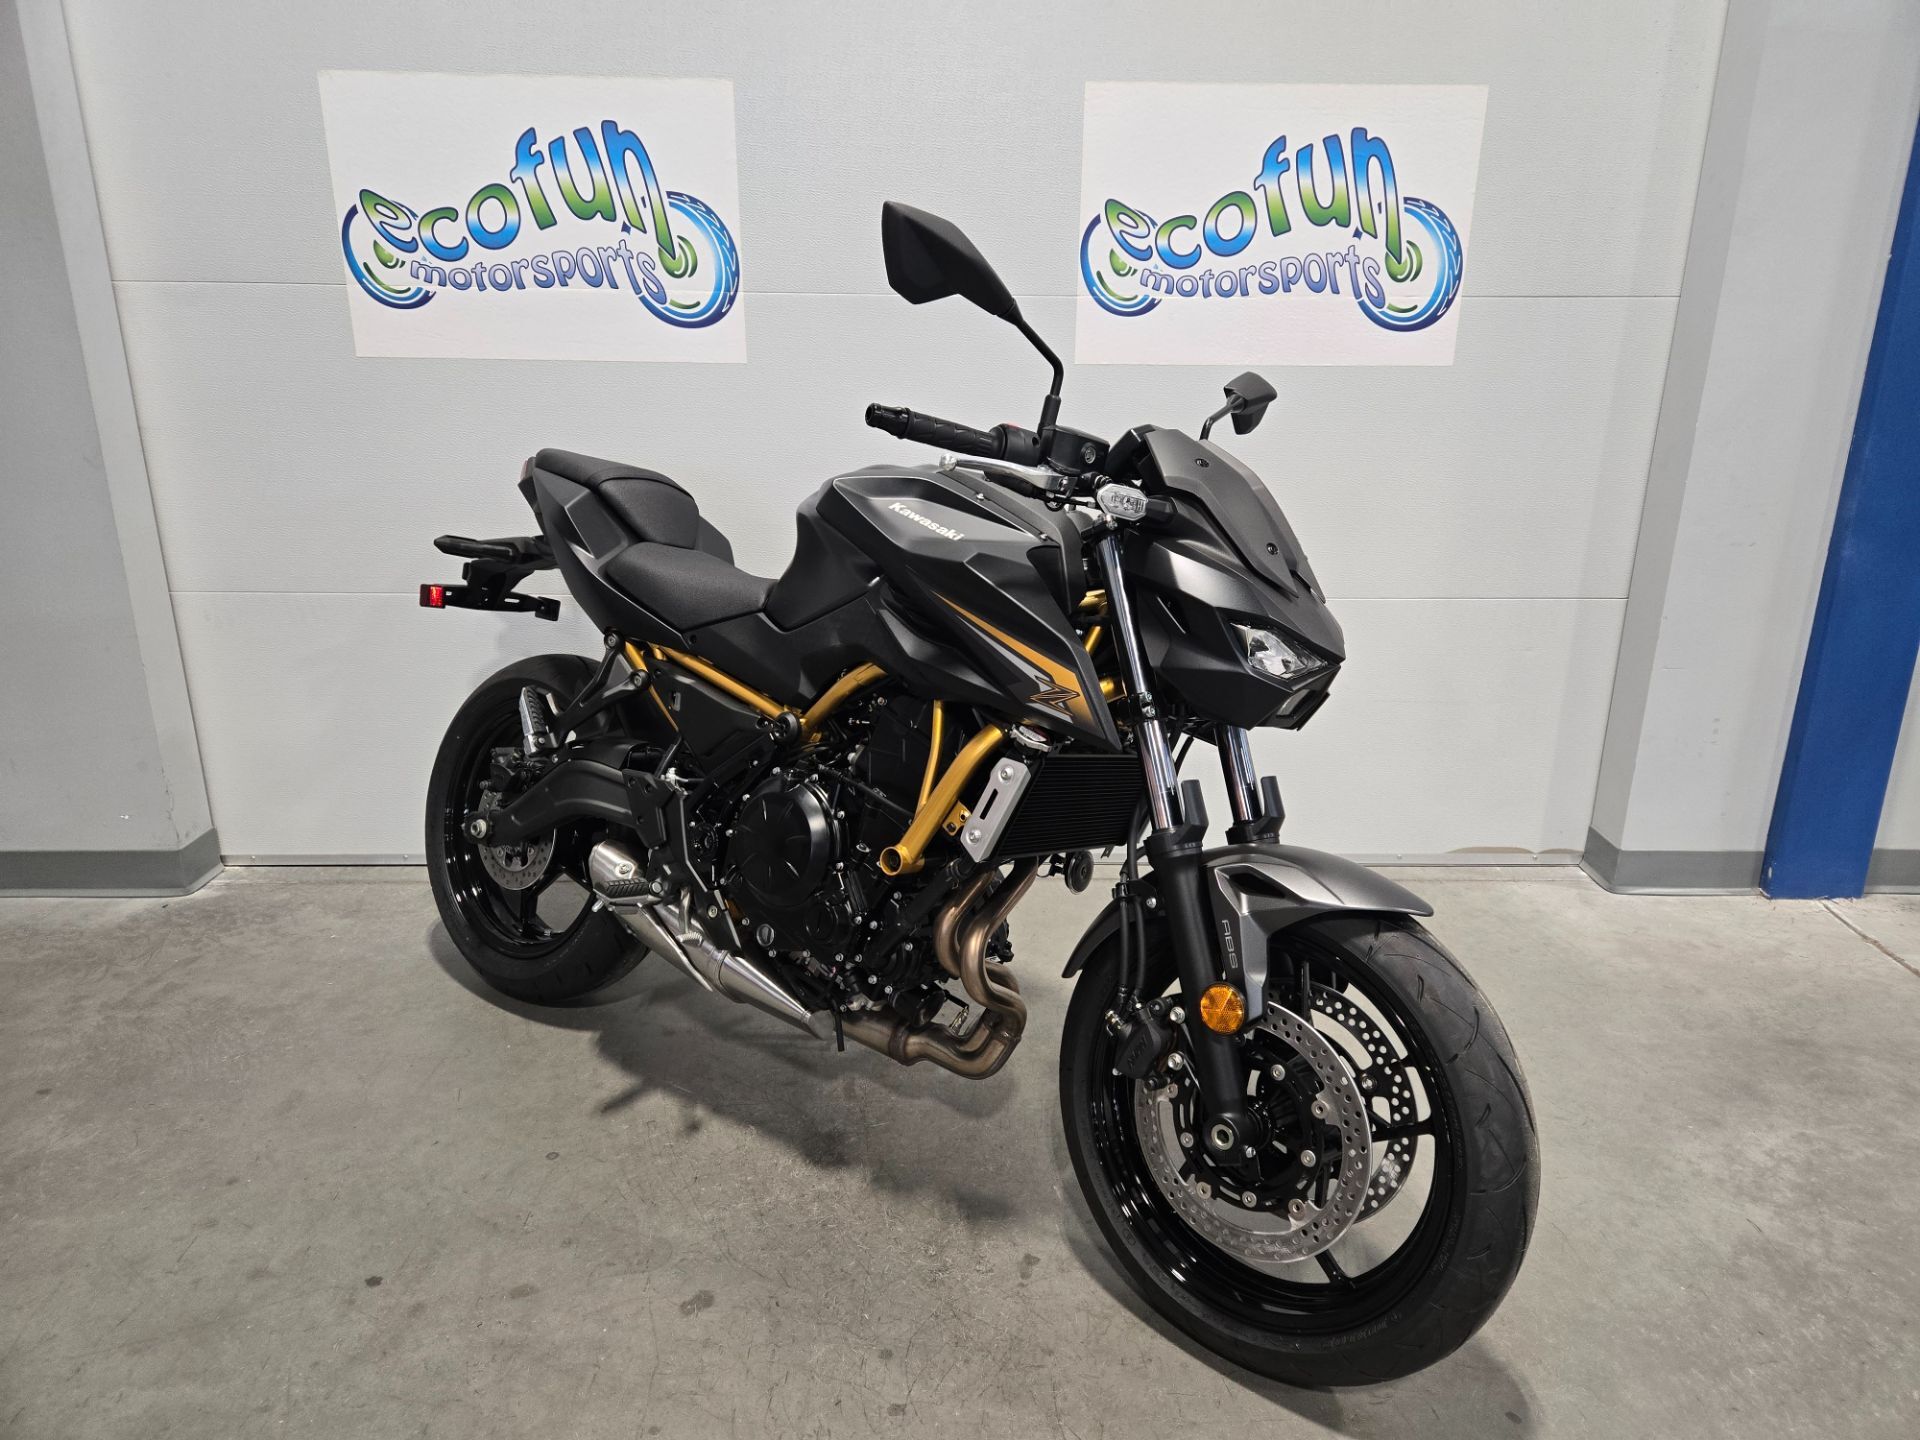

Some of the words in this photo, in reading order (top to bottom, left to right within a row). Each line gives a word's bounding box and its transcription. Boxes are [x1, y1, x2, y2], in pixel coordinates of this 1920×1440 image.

[359, 120, 676, 262] ecofun
[1105, 127, 1403, 269] ecofun
[410, 239, 668, 305] motorsports
[1140, 244, 1386, 309] motorsports
[888, 502, 965, 541] Kawasaki
[1221, 919, 1238, 969] ABS
